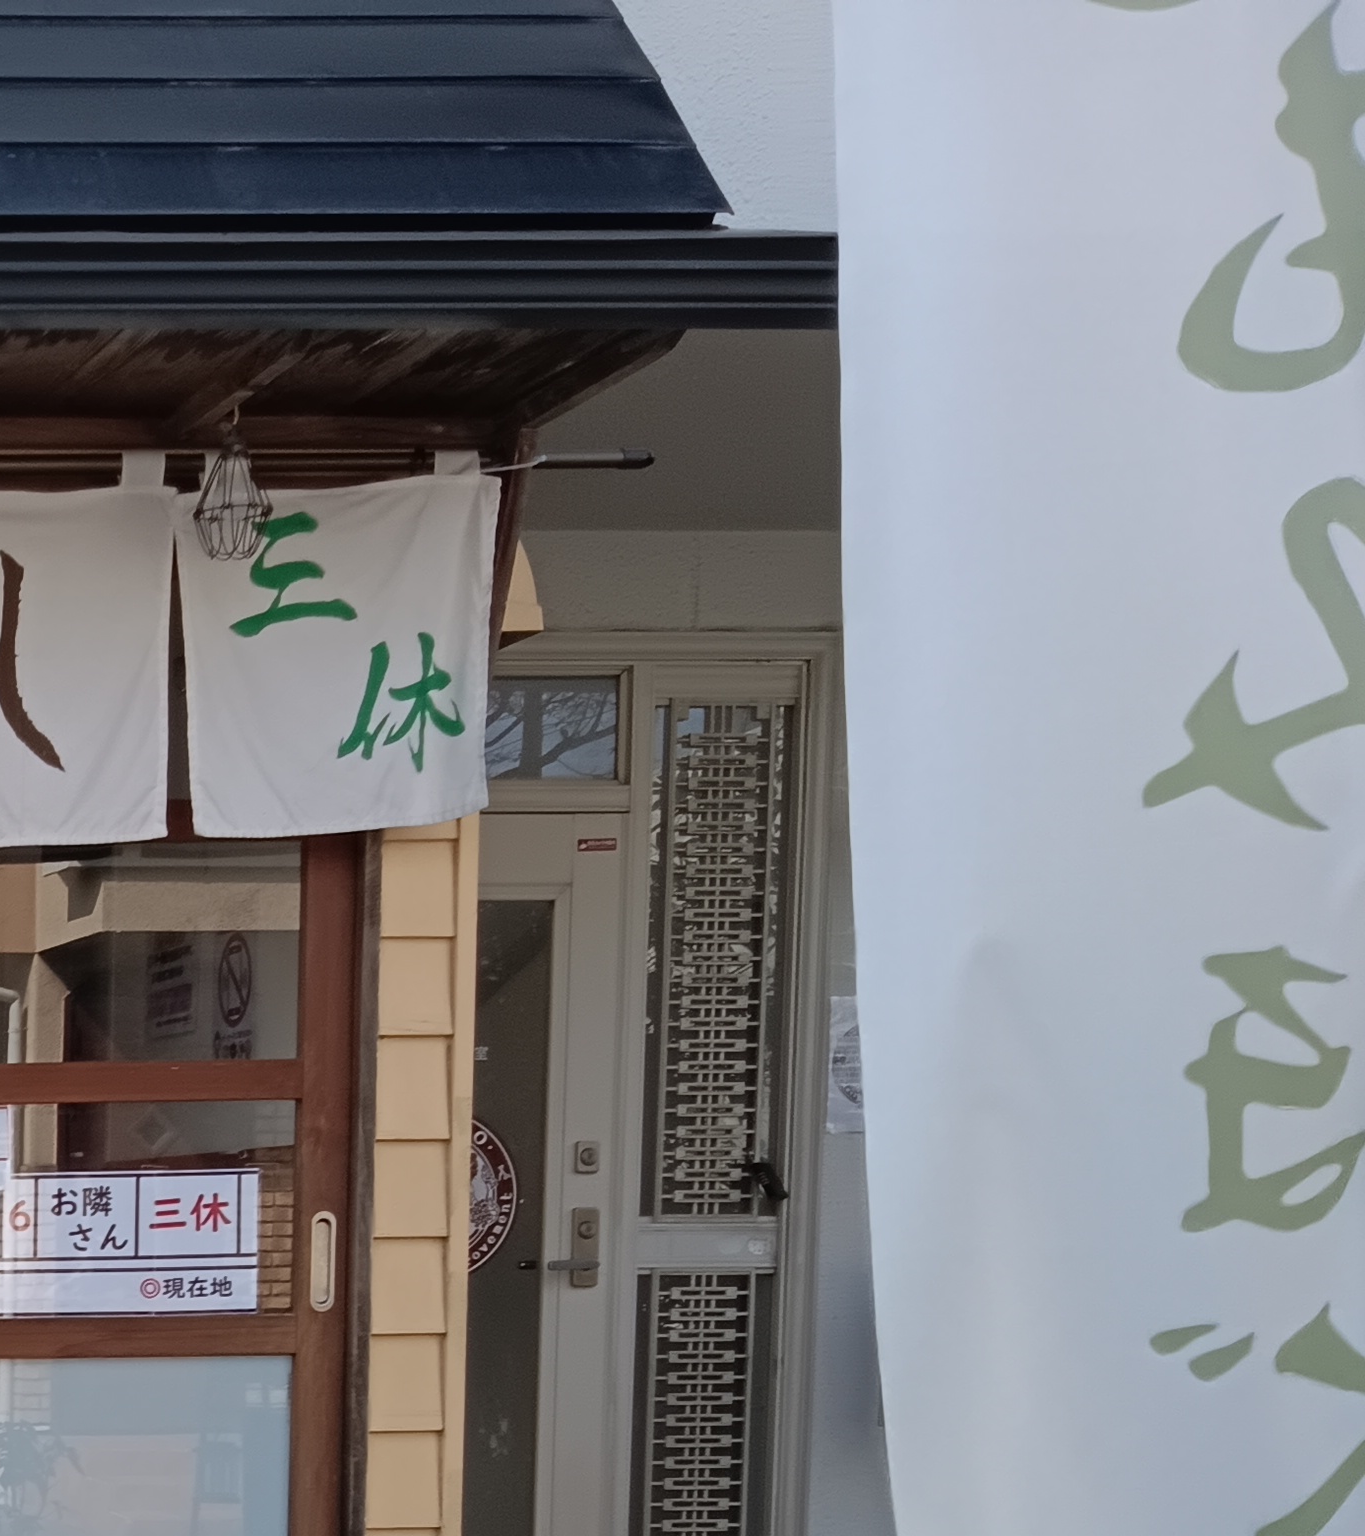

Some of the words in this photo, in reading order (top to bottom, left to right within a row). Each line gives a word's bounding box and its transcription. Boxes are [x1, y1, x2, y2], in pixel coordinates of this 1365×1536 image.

[229, 510, 466, 773] 三休
[8, 1201, 32, 1231] 6
[50, 1186, 113, 1218] お隣
[148, 1192, 233, 1233] 三休
[68, 1223, 130, 1253] さん
